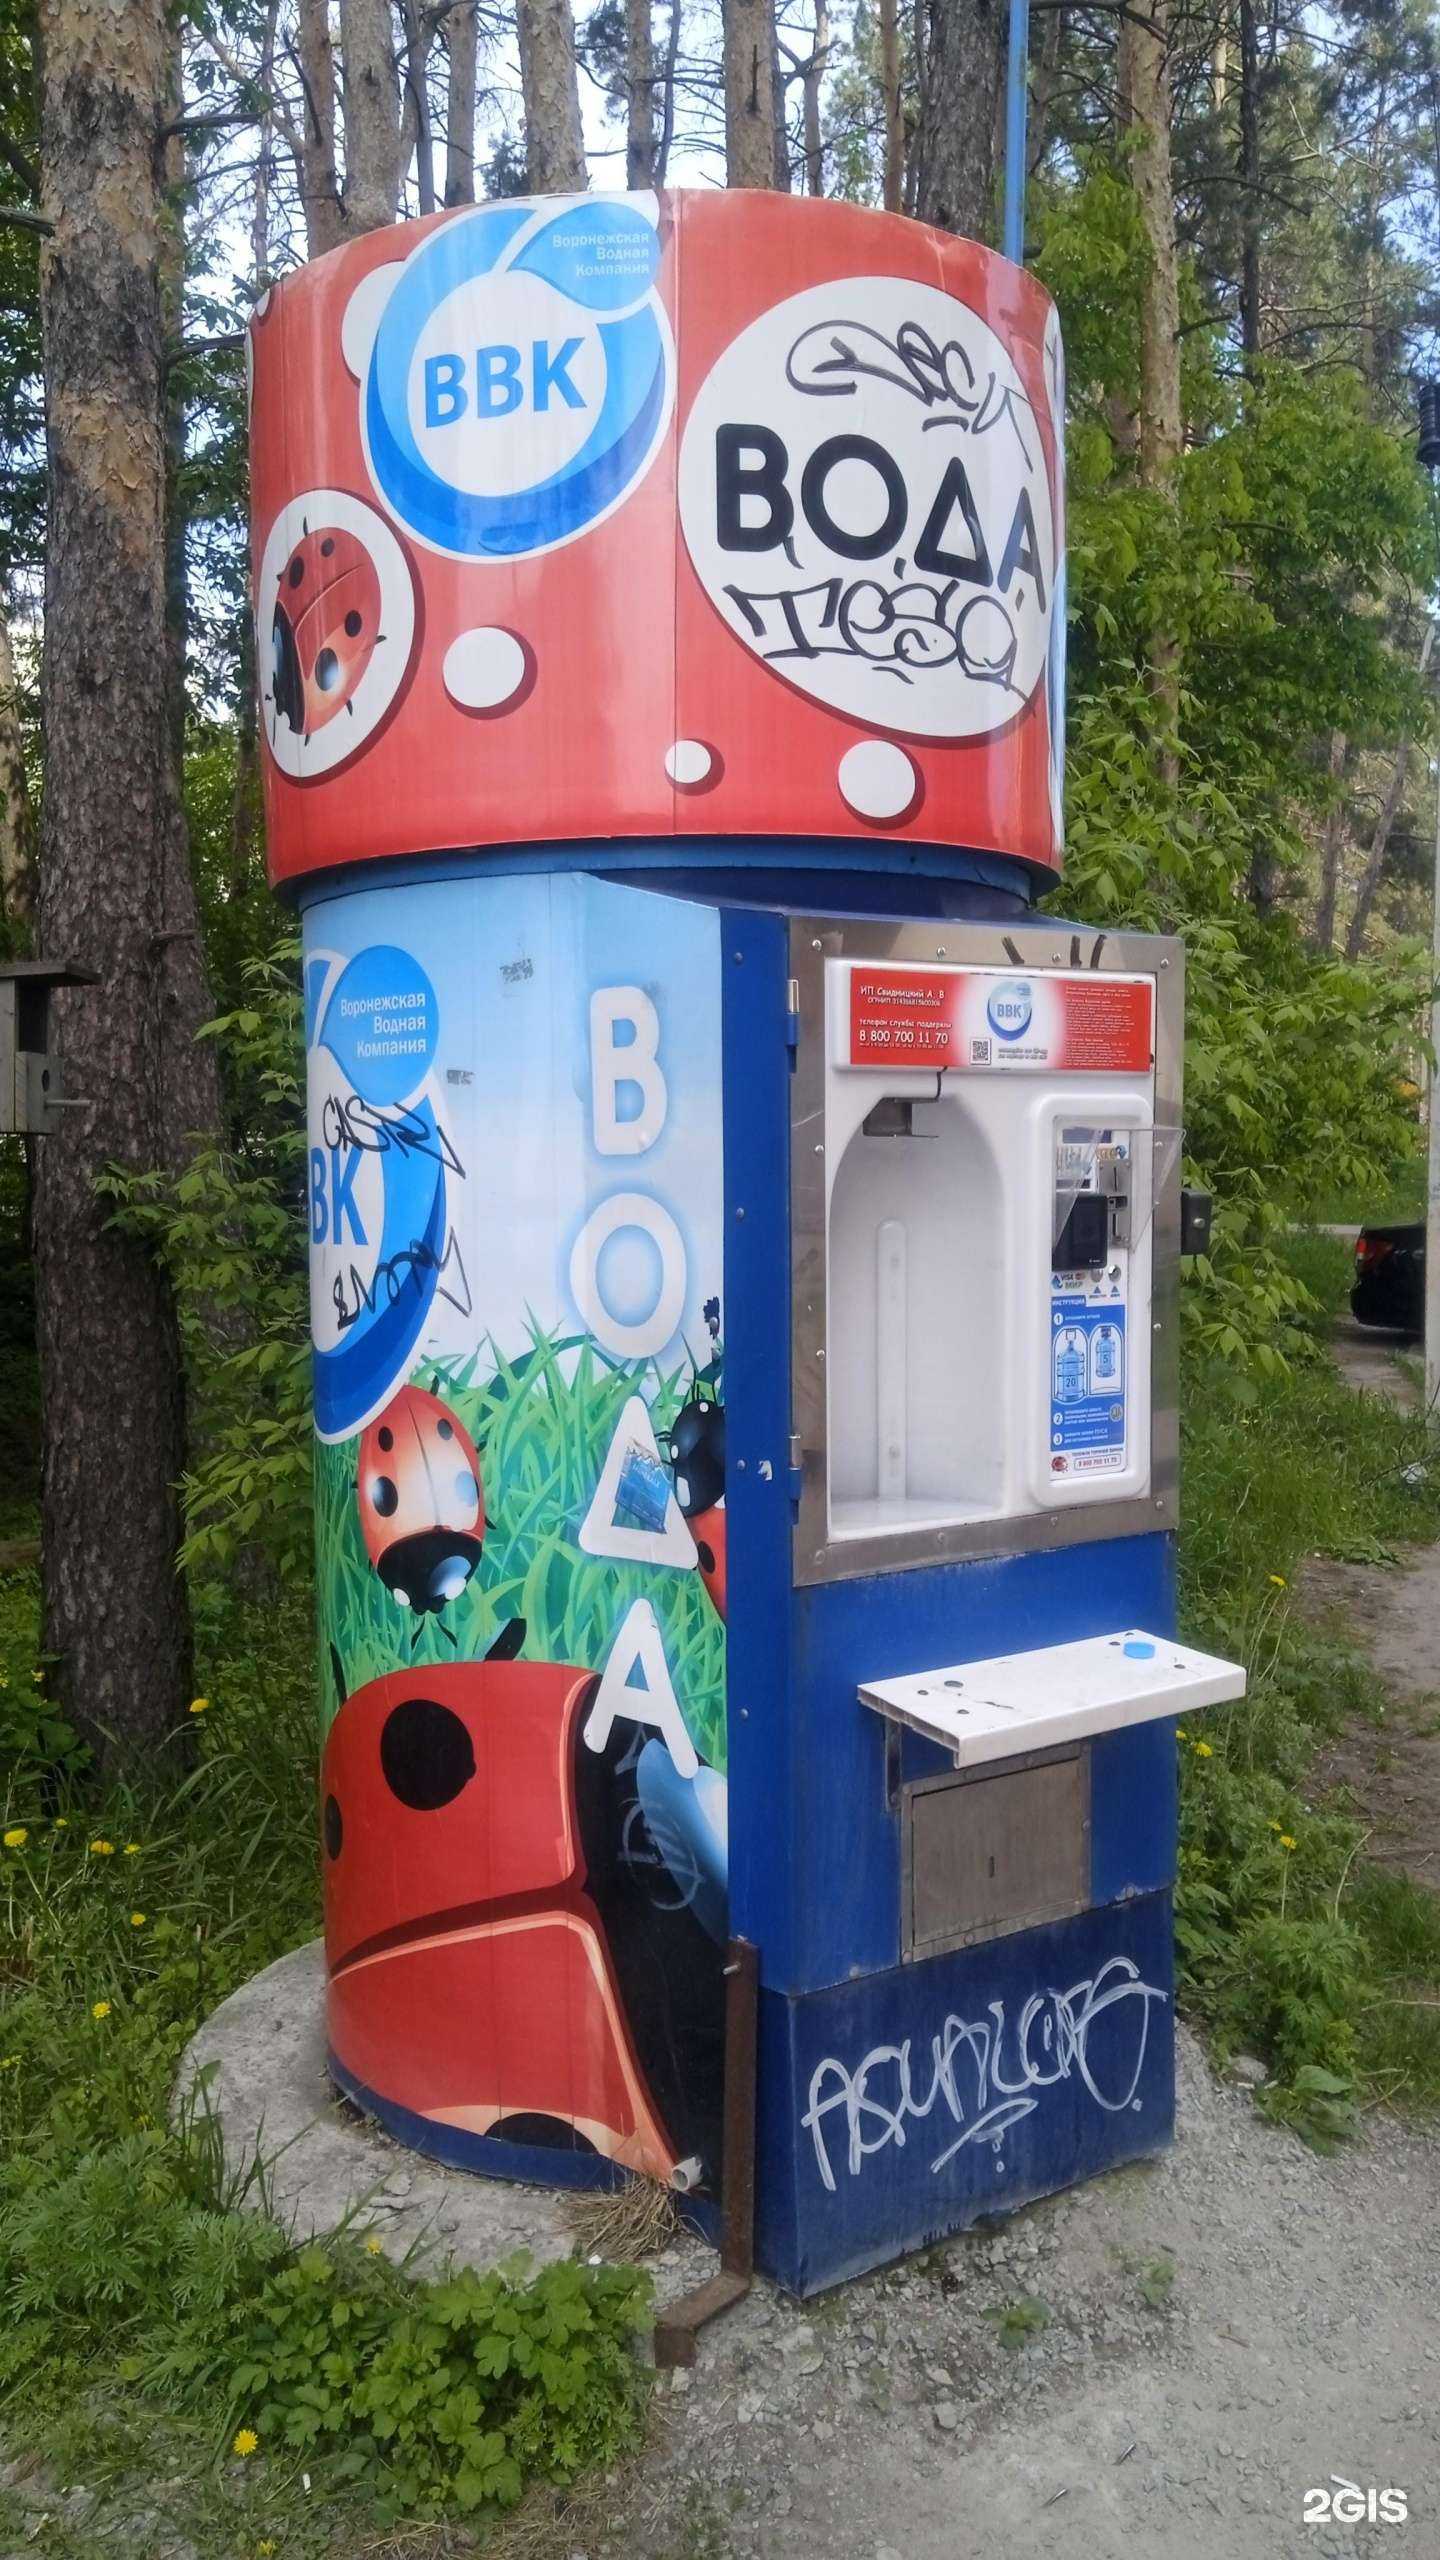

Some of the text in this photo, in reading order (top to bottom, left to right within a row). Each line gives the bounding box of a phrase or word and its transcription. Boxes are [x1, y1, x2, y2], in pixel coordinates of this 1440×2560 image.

[551, 232, 650, 248] Воронежская
[596, 247, 650, 261] Водная
[575, 263, 650, 277] Компания
[424, 336, 588, 429] ВВК
[715, 422, 1047, 614] ВОДА
[860, 985, 874, 996] ИП
[876, 986, 924, 999] Свидницкий
[340, 993, 426, 1018] Воронежская
[997, 1003, 1023, 1018] ВВК
[373, 1015, 426, 1035] Водная
[860, 1018, 953, 1030] телефон службы поддержки
[859, 1029, 949, 1045] 8 800 700 11 70
[356, 1038, 427, 1058] Компания
[310, 1146, 369, 1246] ВК
[1102, 1352, 1109, 1364] 5
[1066, 1378, 1077, 1388] 20
